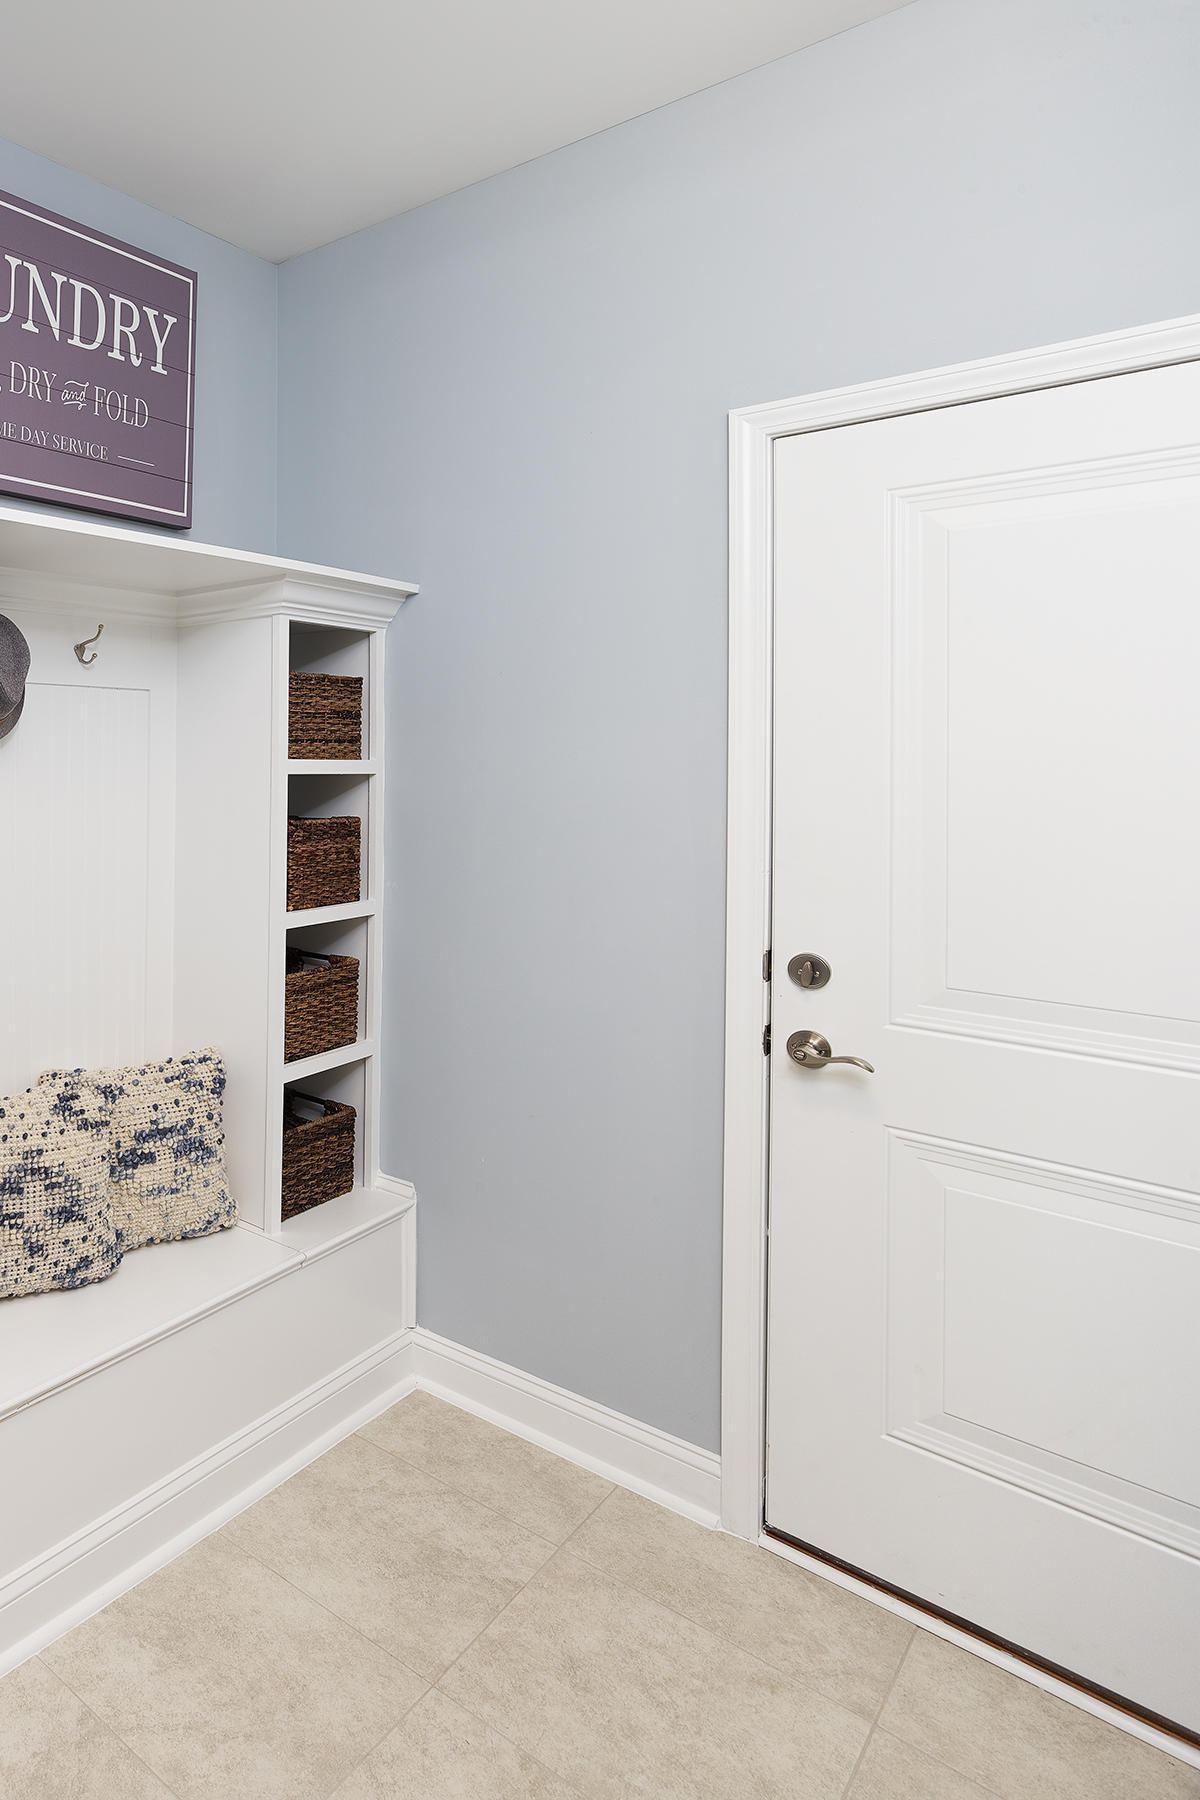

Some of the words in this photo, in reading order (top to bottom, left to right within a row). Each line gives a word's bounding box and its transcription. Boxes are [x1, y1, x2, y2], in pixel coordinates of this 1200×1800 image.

[9, 360, 57, 402] DRY
[60, 379, 90, 410] and
[94, 386, 149, 428] FOLD
[20, 427, 49, 447] DAY
[52, 434, 109, 461] SERVICE
